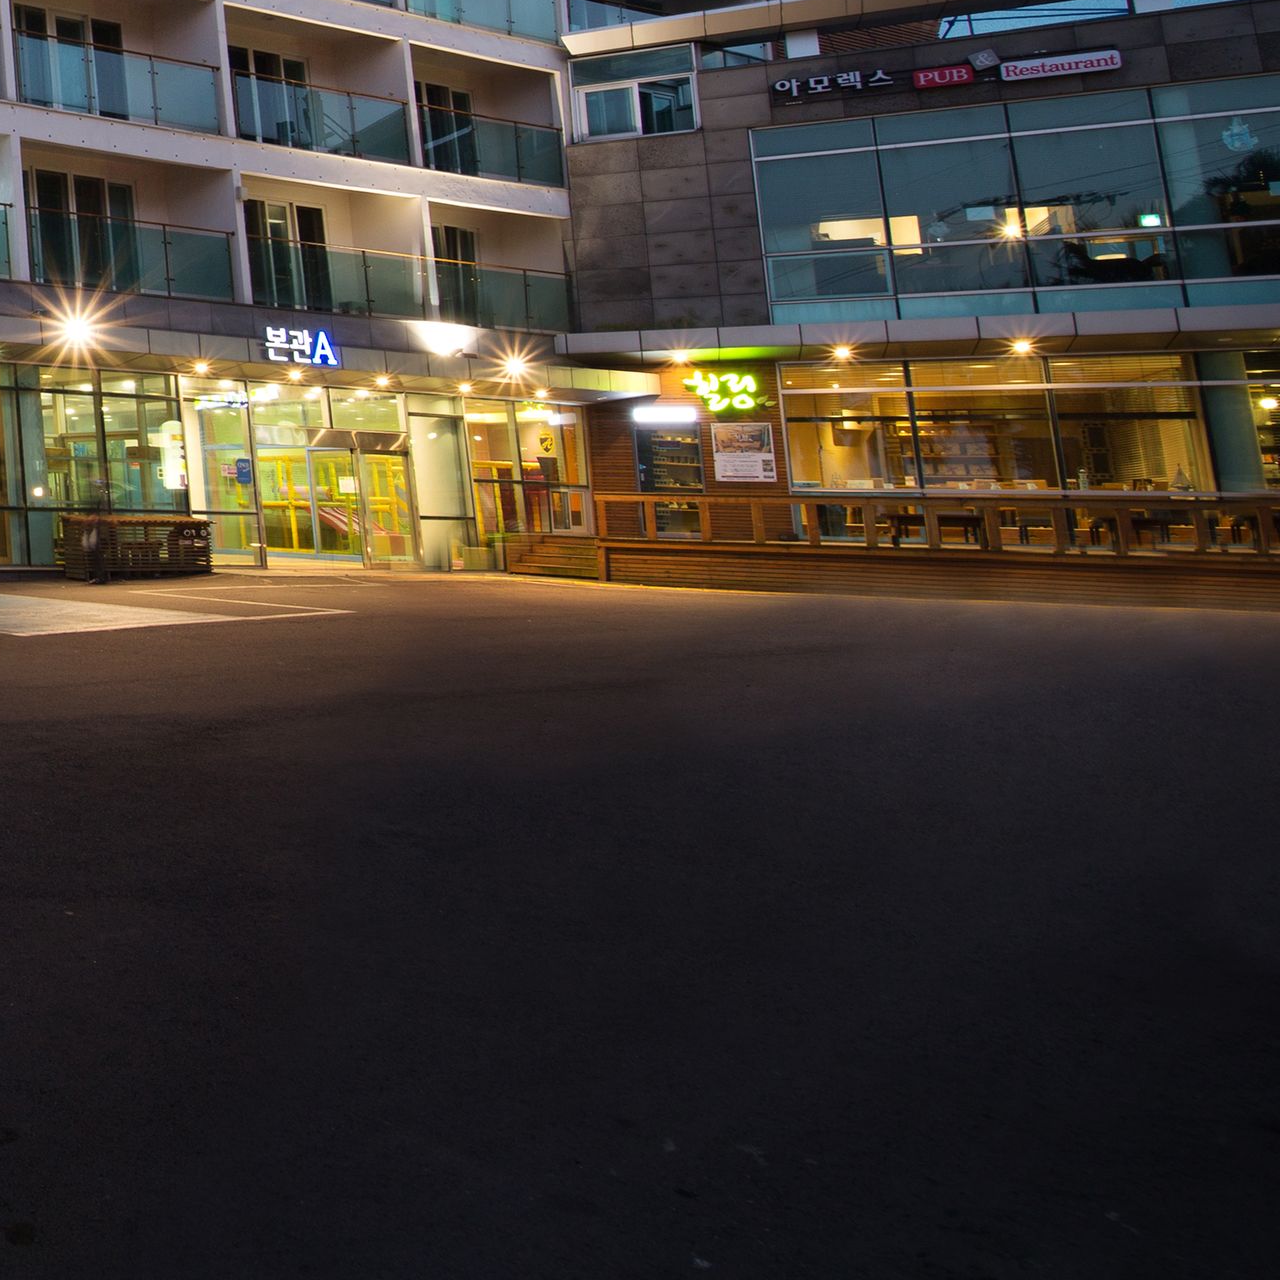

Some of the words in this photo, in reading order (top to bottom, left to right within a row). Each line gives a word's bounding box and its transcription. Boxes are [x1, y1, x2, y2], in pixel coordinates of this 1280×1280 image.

[774, 70, 894, 97] 아모렉스
[918, 68, 969, 86] PUB
[974, 52, 994, 67] &
[1003, 53, 1119, 79] Restaurant
[682, 370, 757, 412] 힐링
